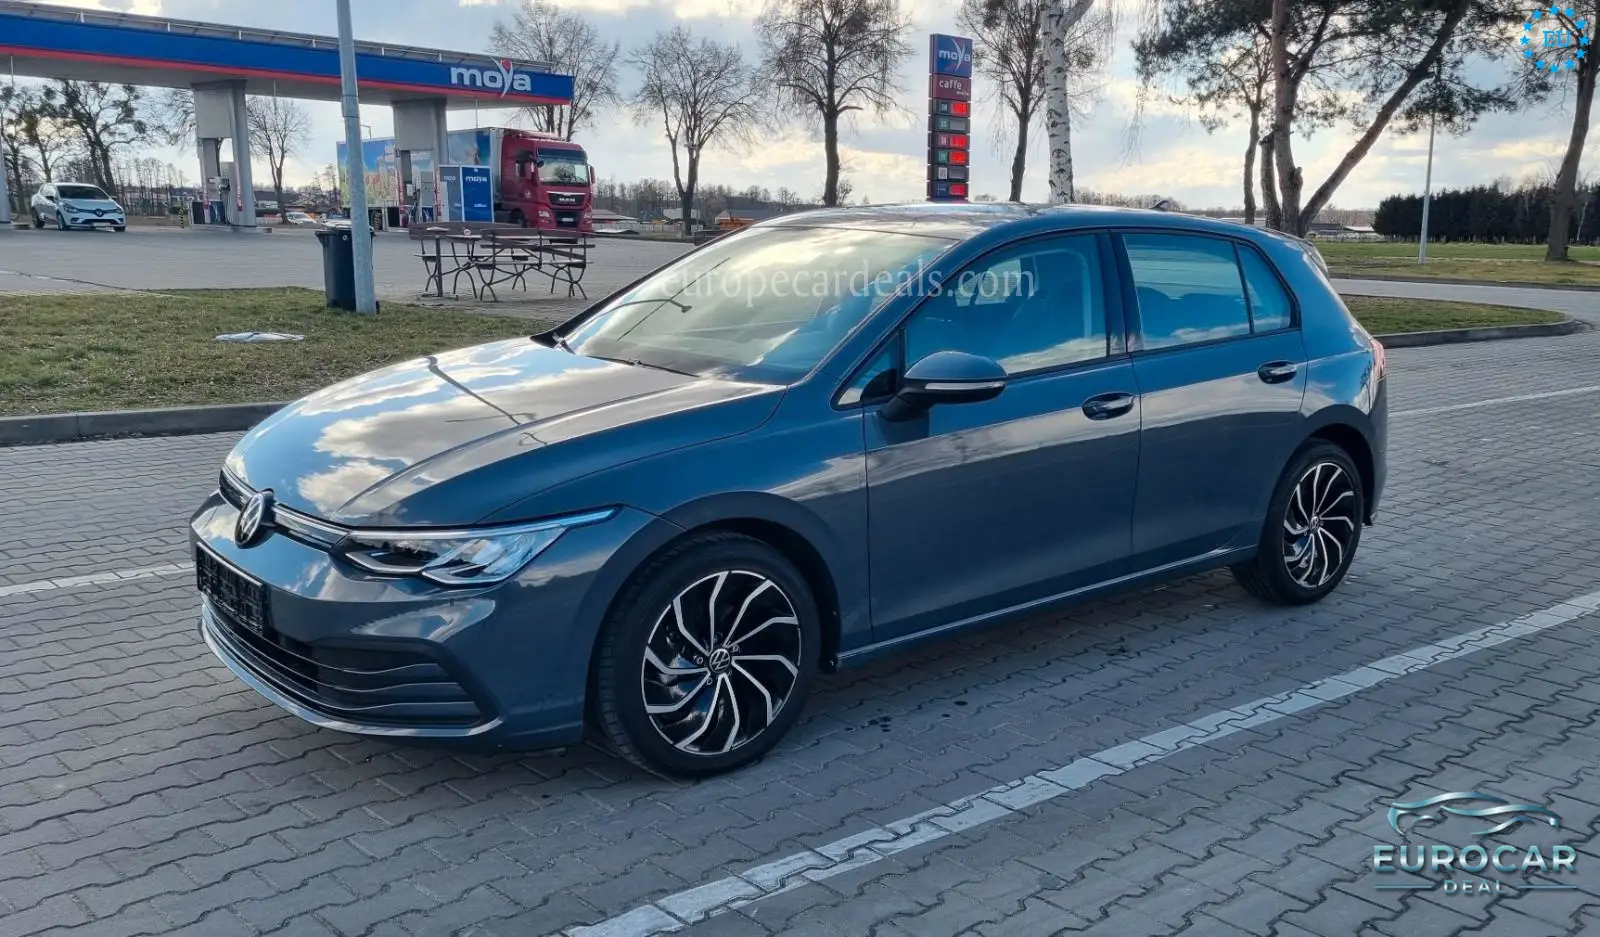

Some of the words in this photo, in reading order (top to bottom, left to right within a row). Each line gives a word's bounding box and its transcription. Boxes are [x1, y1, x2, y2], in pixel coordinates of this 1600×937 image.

[939, 38, 971, 72] moya
[450, 56, 532, 98] moya
[465, 175, 488, 183] moya
